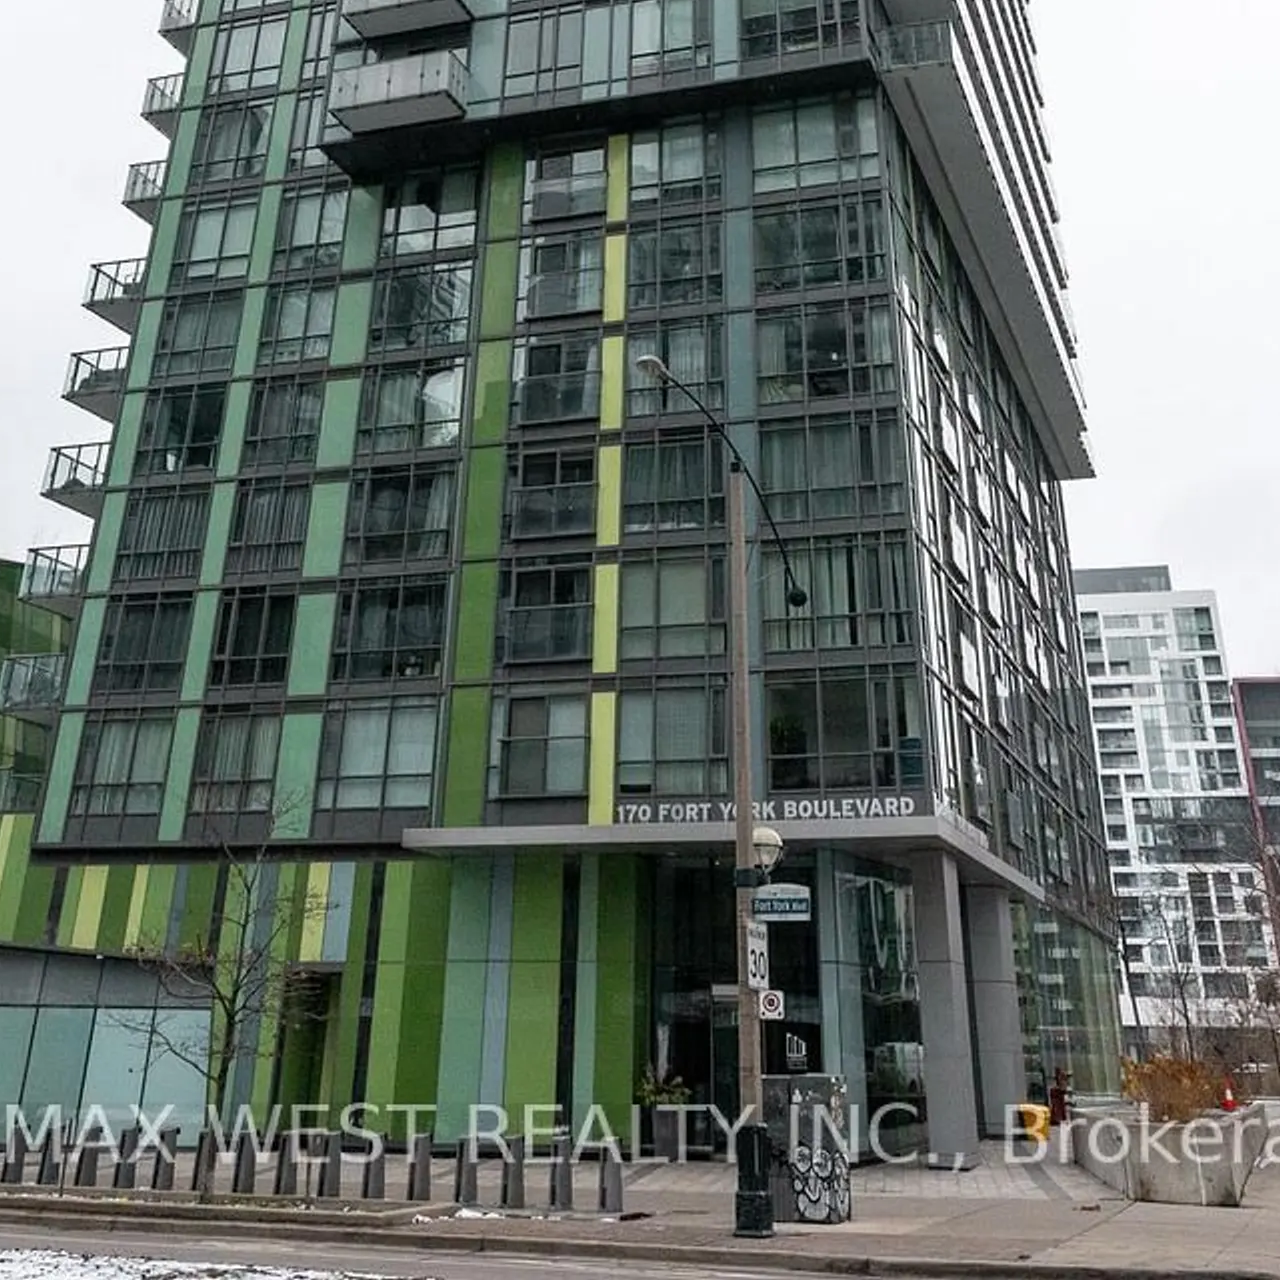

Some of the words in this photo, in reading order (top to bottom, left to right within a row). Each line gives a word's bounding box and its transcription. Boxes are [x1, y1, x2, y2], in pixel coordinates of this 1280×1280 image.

[617, 803, 652, 824] 170
[659, 803, 712, 822] FORT
[720, 800, 776, 822] YRK
[783, 796, 915, 820] BOULEVARD
[749, 947, 768, 980] 30
